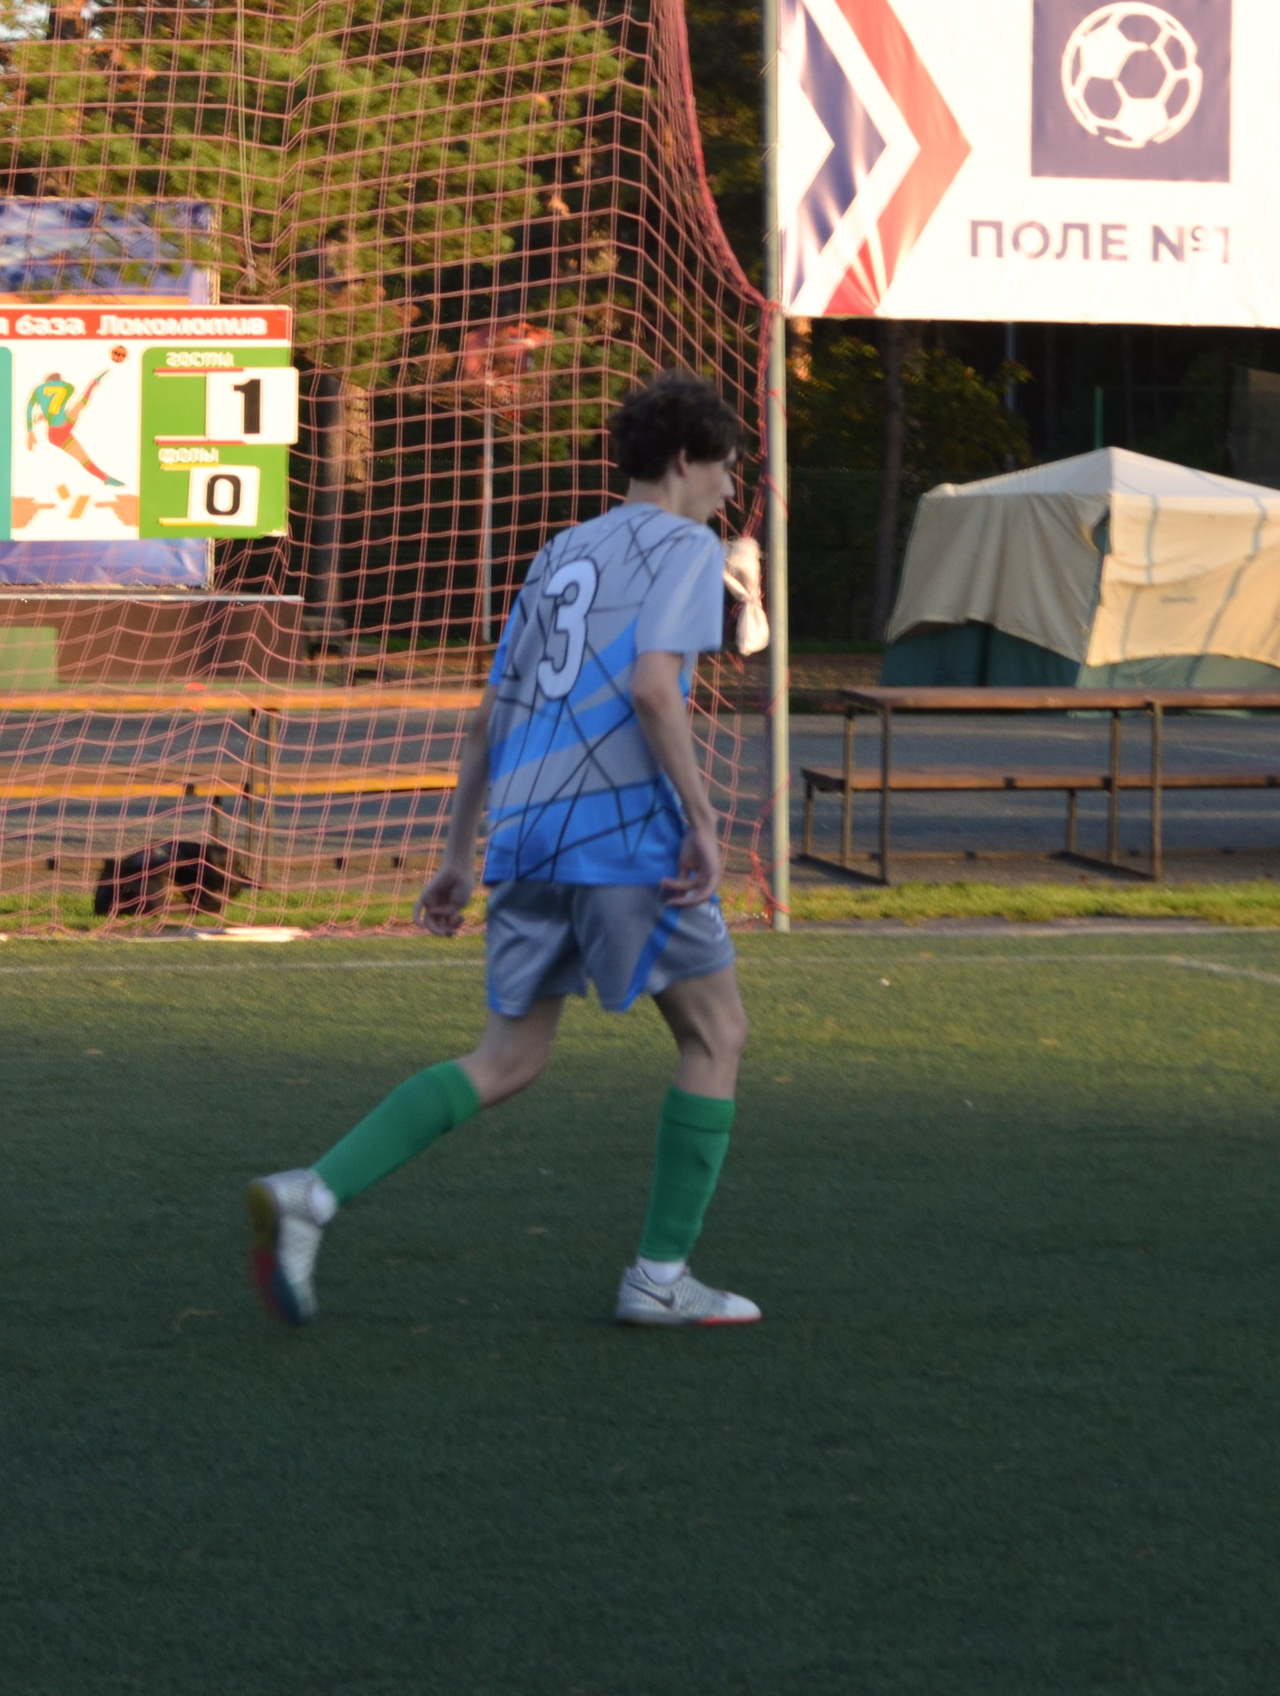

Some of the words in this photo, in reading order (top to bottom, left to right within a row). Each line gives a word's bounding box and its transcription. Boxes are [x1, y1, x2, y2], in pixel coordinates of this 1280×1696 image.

[970, 219, 1128, 261] ПОЛЕ
[15, 314, 86, 336] база
[43, 386, 68, 416] 7
[233, 378, 261, 435] 1
[206, 474, 242, 516] 0
[537, 556, 599, 701] 3
